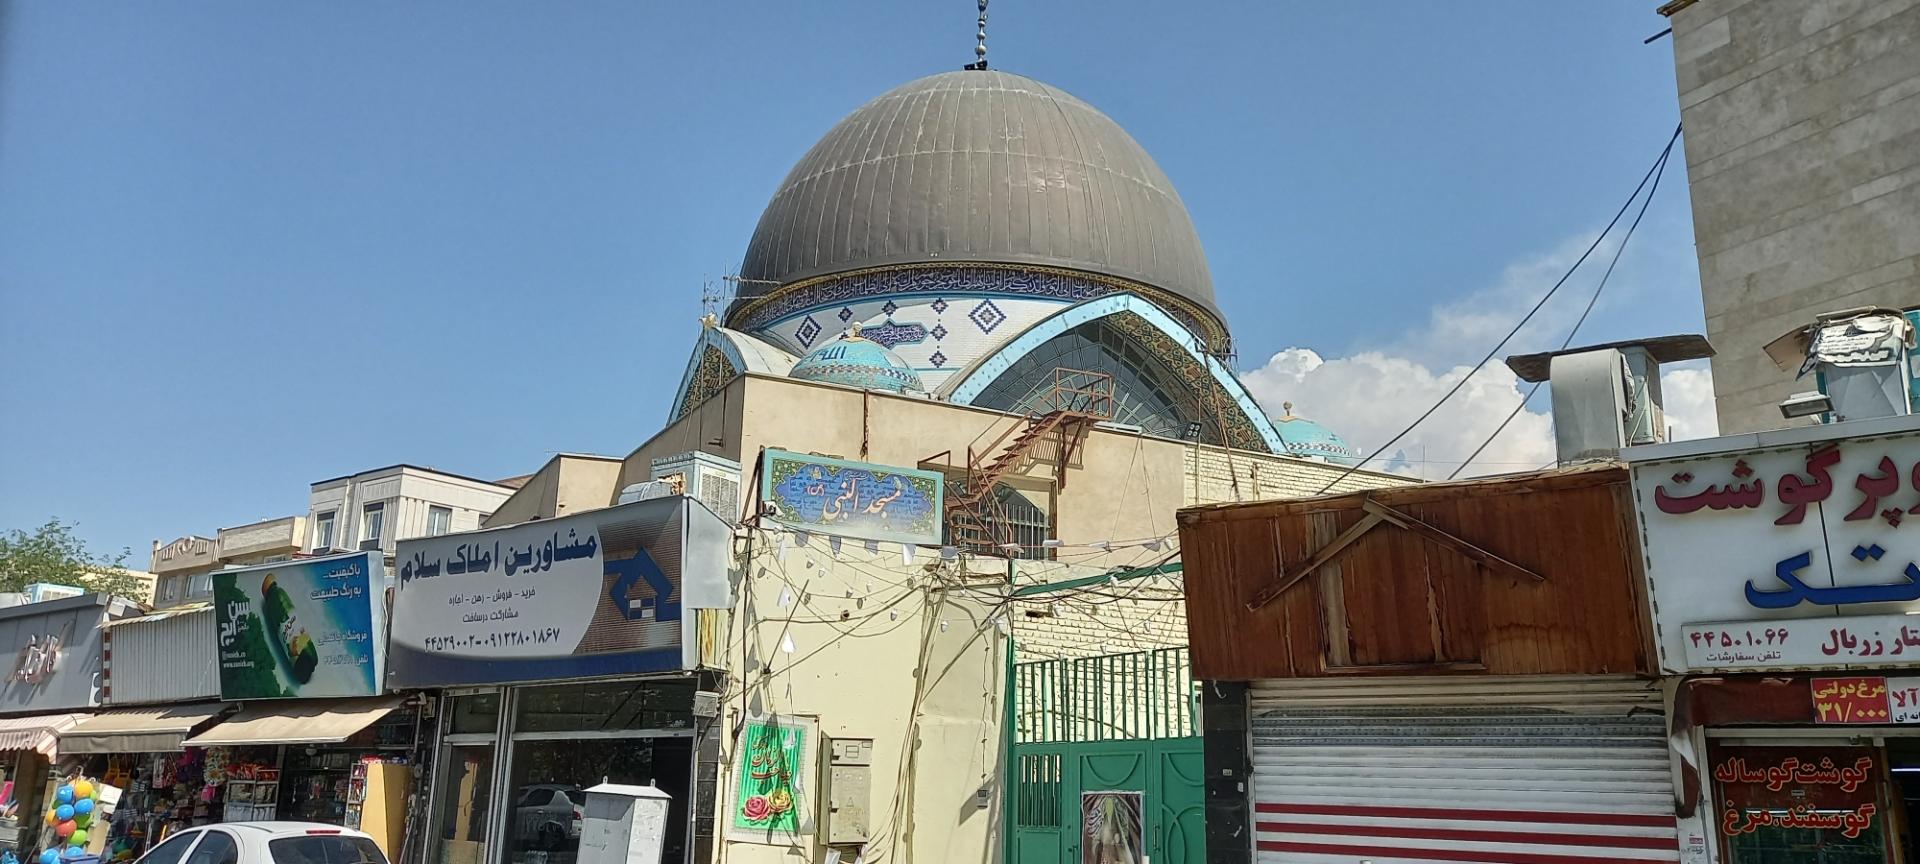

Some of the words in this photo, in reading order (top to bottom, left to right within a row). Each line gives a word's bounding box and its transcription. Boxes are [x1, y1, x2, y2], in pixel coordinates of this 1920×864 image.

[1655, 442, 1841, 526] گوشت
[862, 489, 901, 519] مسجد
[446, 540, 499, 576] املاک
[505, 527, 598, 577] مشاورین
[400, 551, 441, 591] سلام
[448, 593, 464, 606] اجاره
[471, 594, 485, 605] رهن
[492, 588, 513, 602] فروش
[521, 586, 536, 599] خرید
[489, 606, 519, 621] مشارکت
[1706, 651, 1755, 664] سفارشات
[1758, 650, 1781, 662] تلفن
[1814, 681, 1856, 699] دولتی
[1856, 679, 1886, 698] مرغ
[1817, 702, 1888, 722] ۳۱/۰۰۰
[1714, 756, 1799, 791] گوساله
[1794, 756, 1872, 793] گوشت
[1723, 799, 1774, 835] مرغ
